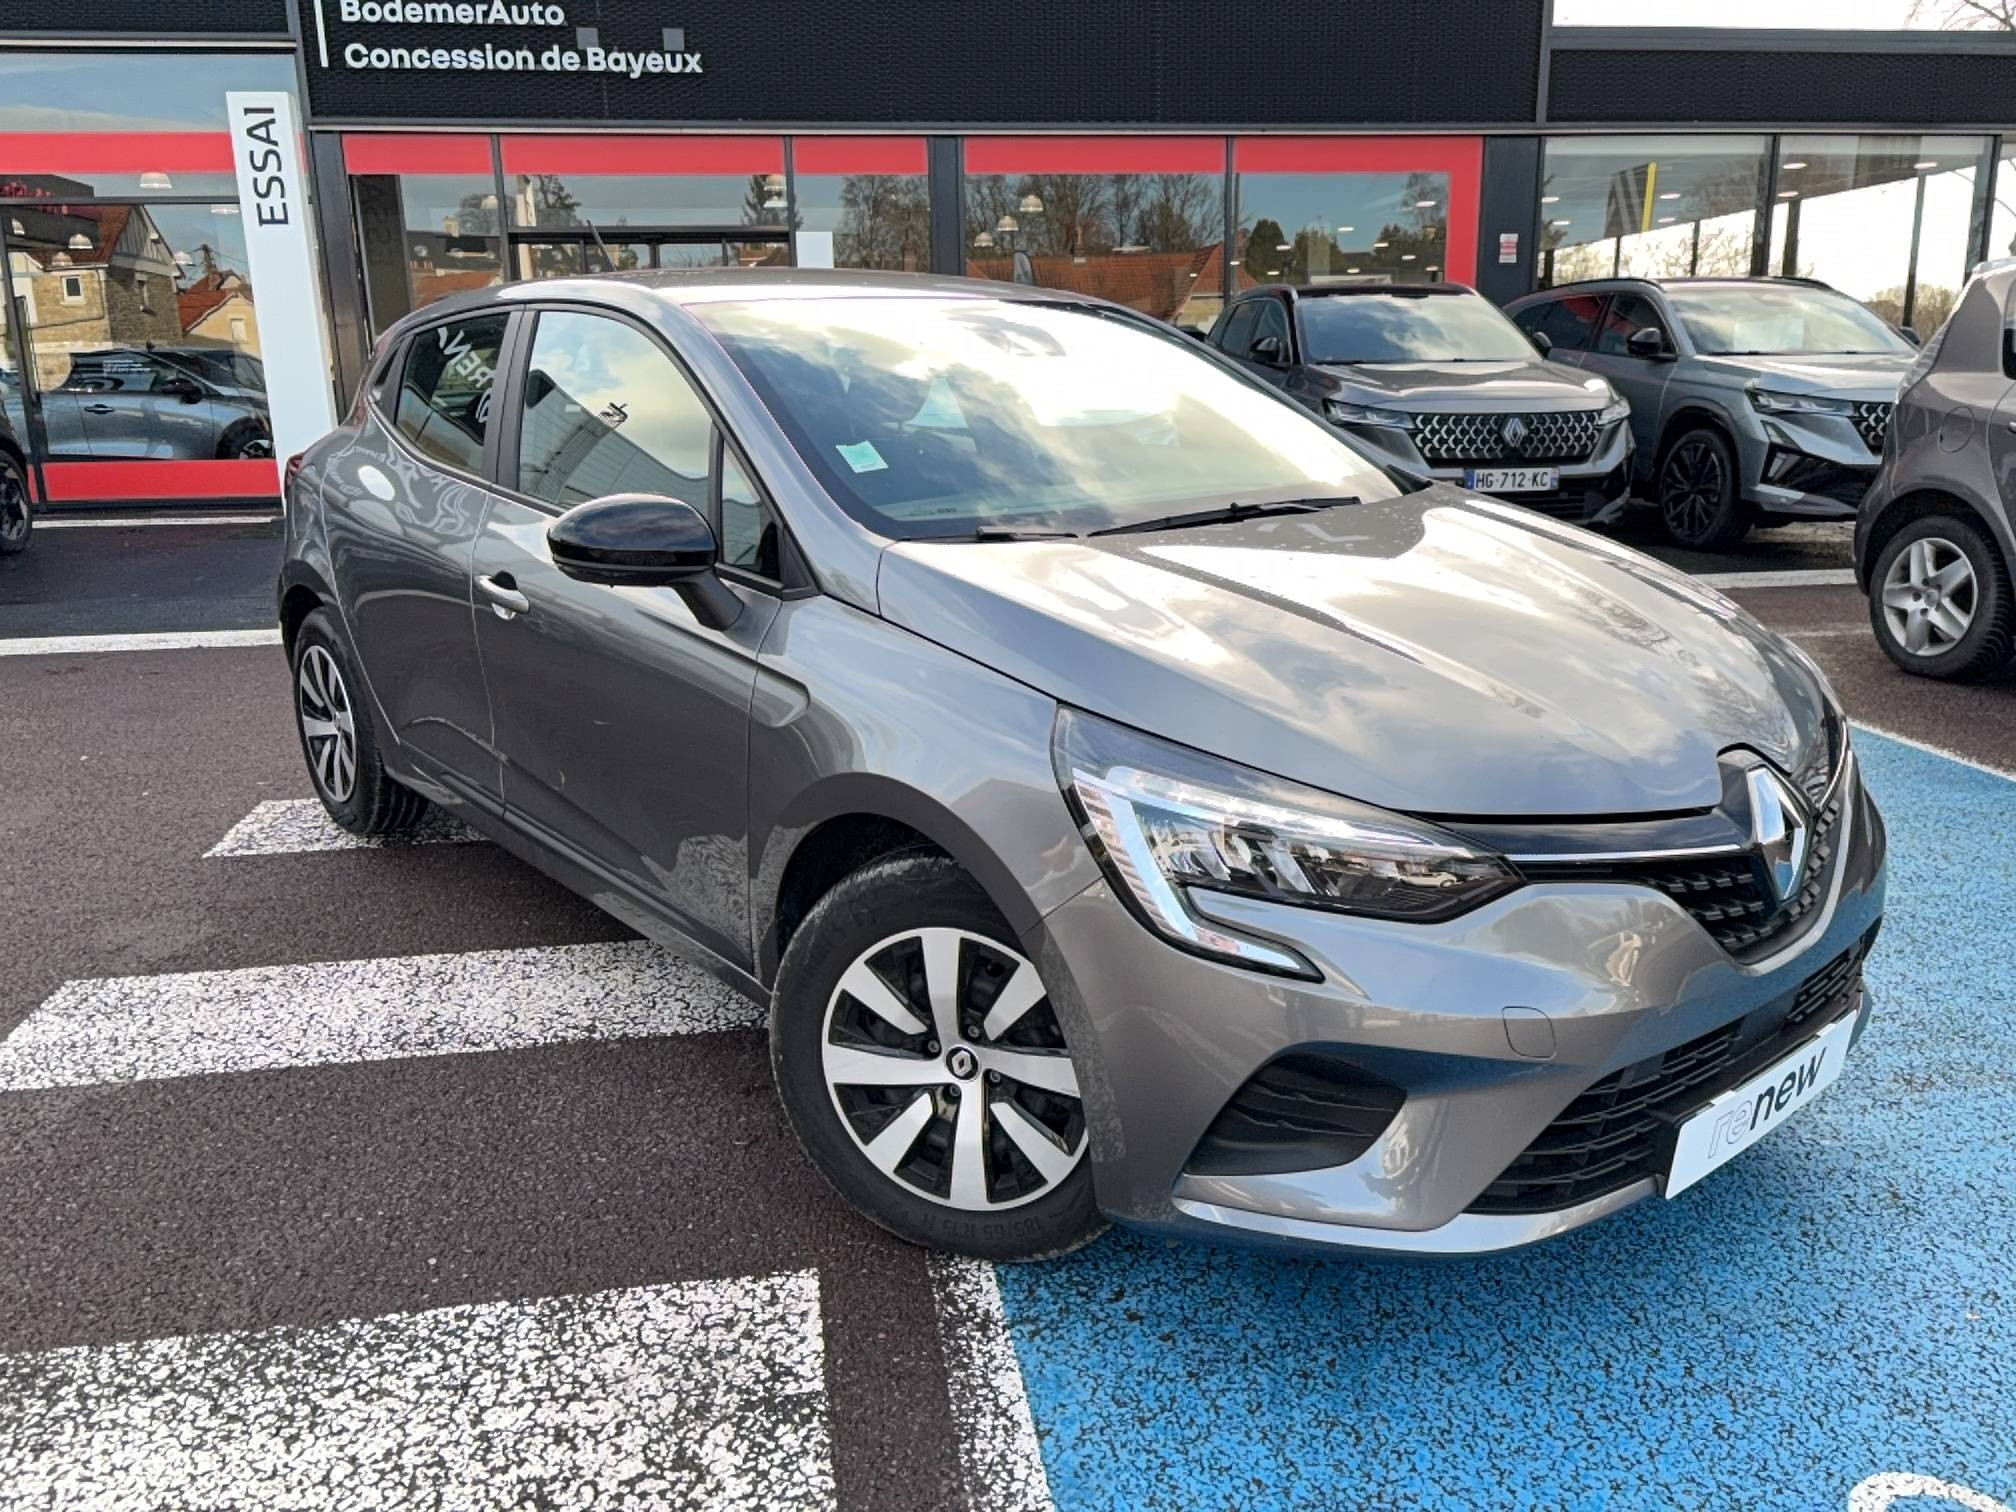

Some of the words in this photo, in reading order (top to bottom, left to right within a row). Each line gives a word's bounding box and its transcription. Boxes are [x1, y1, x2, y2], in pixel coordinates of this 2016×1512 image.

[340, 0, 566, 25] BodemerAuto
[344, 43, 536, 71] Concession
[541, 45, 582, 71] de
[587, 47, 704, 79] Bayeux
[243, 106, 289, 227] ESSAI
[1475, 471, 1549, 489] HG-712-KC
[1707, 1046, 1827, 1159] renew
